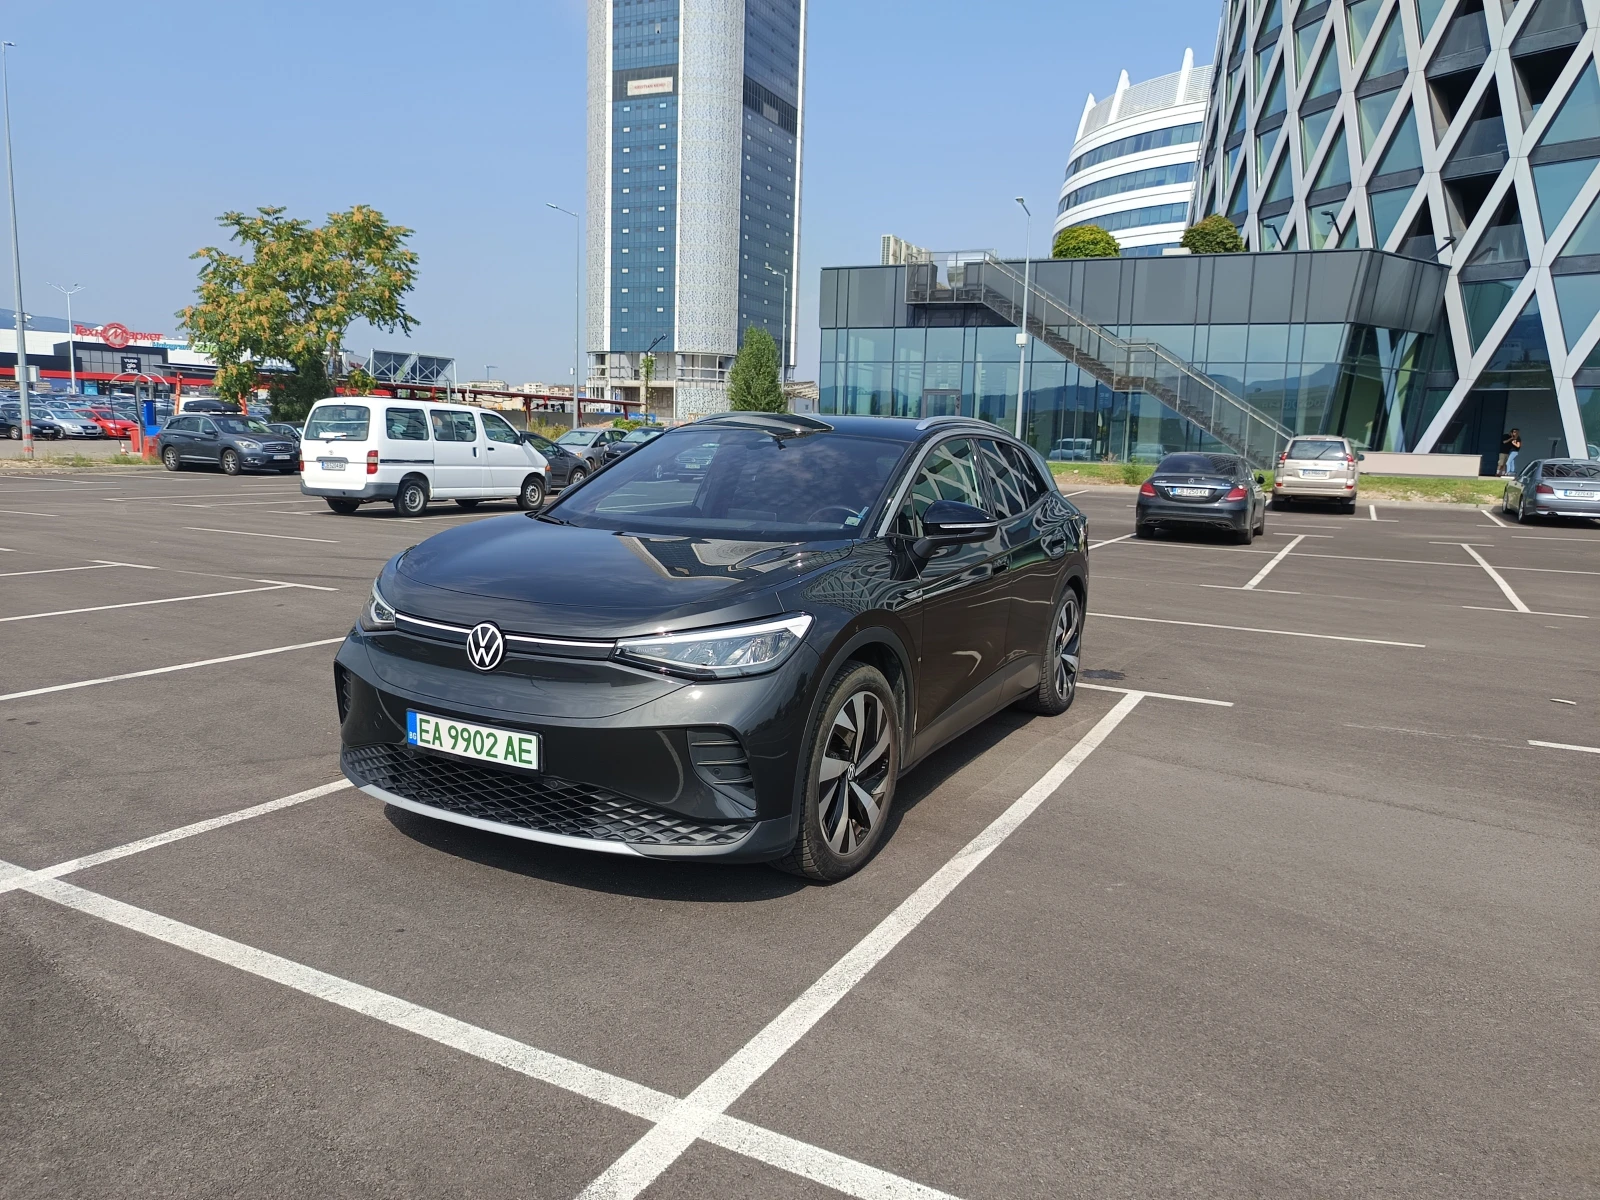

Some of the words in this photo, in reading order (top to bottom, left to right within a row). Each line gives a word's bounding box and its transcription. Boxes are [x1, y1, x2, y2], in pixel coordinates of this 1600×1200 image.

[409, 731, 417, 740] BG
[419, 718, 443, 748] EA
[448, 725, 498, 758] 9902
[504, 736, 533, 765] AE
